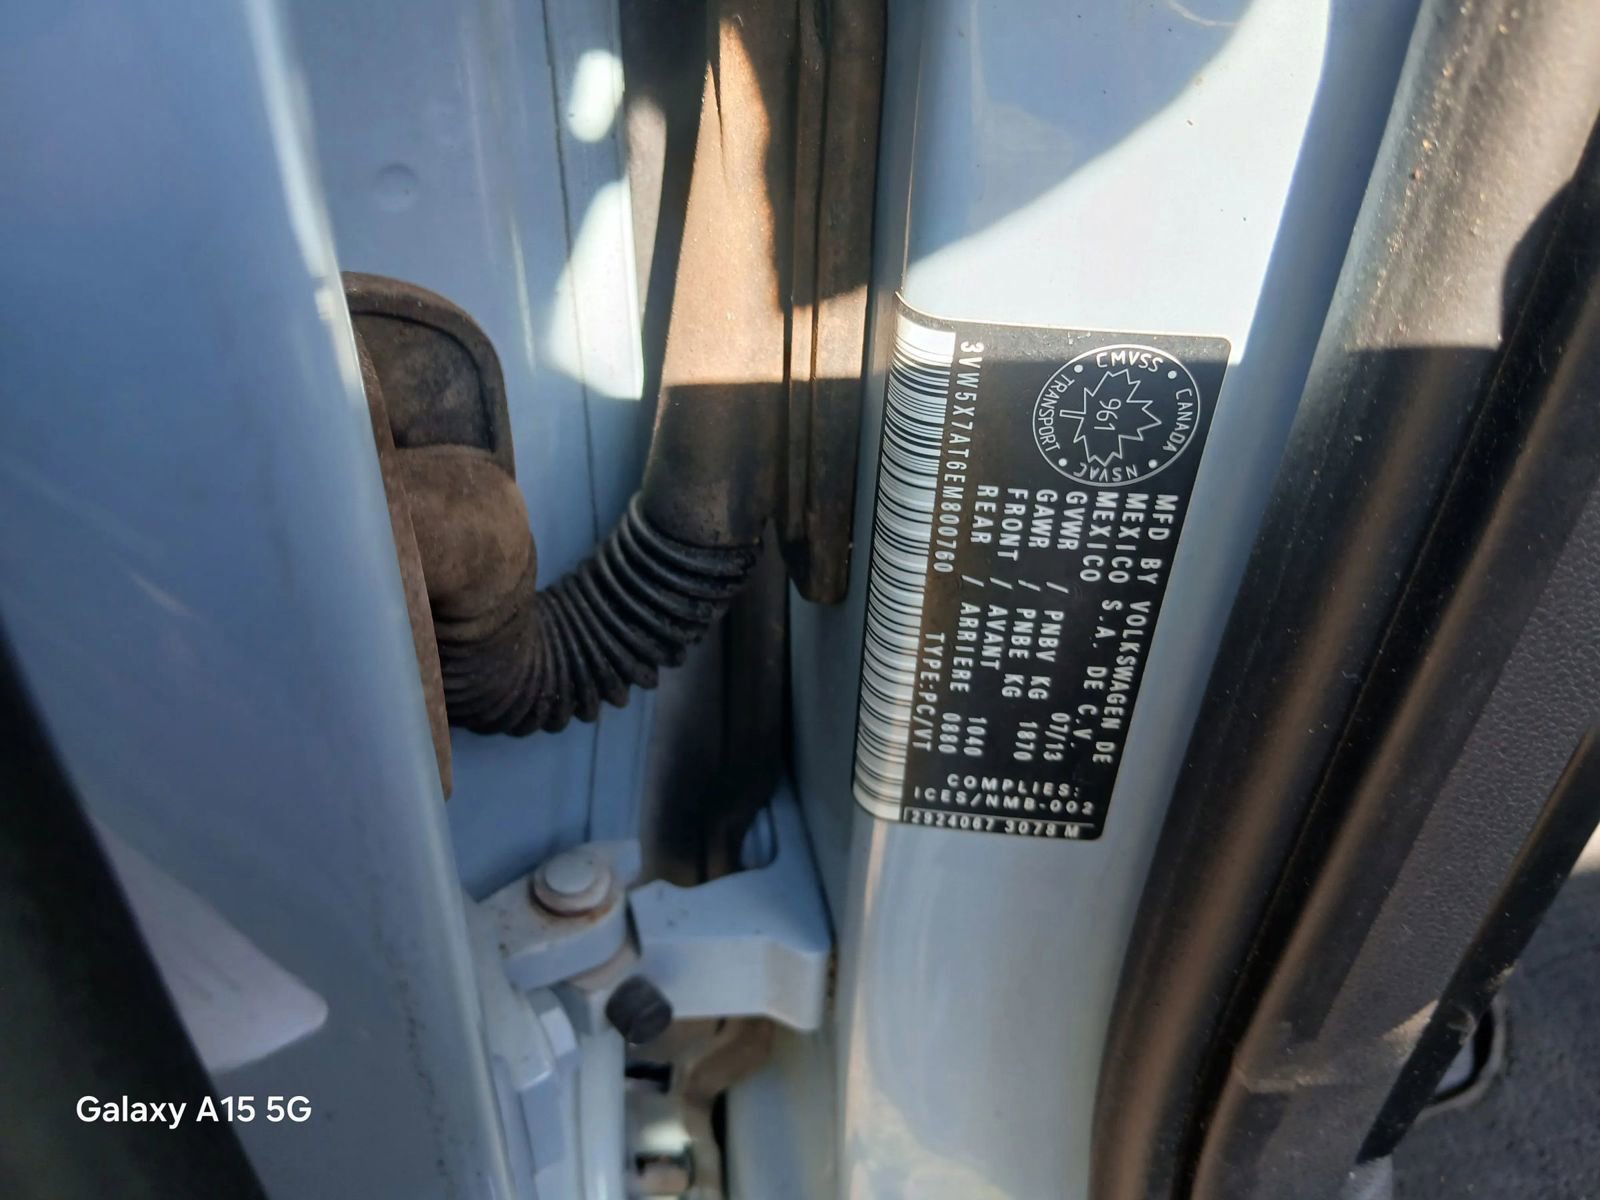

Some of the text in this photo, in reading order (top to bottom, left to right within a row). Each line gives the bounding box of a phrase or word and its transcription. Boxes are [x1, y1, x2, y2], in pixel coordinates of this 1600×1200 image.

[1096, 351, 1163, 372] CMVSS
[1038, 374, 1075, 451] TRANSPORT
[1163, 388, 1193, 452] CANADA
[933, 341, 984, 573] 3VW5X7AT6EM800760
[1073, 462, 1137, 482] NSVAC
[970, 485, 999, 543] REAR
[997, 488, 1029, 561] FRONT
[1028, 489, 1058, 548] GAWR
[1057, 491, 1088, 550] GVWR
[1108, 493, 1149, 583] MEXICO
[950, 602, 981, 692] ARRIERE
[980, 604, 1009, 670] AVANT
[1008, 608, 1037, 659] PNBE
[1036, 610, 1065, 662] PNBV
[1043, 491, 1119, 761] MEXICO 07/13
[1092, 495, 1178, 763] MFD BY VOLKSWAGEN DE
[1001, 673, 1025, 698] KG
[1027, 676, 1051, 700] KG
[1083, 666, 1108, 690] DE
[938, 712, 962, 754] 0880
[963, 717, 988, 757] 1040
[1013, 721, 1038, 761] 1870
[914, 786, 1095, 816] ICES/NMB-002
[947, 773, 1080, 798] COMPLIES:
[1064, 825, 1080, 838] M
